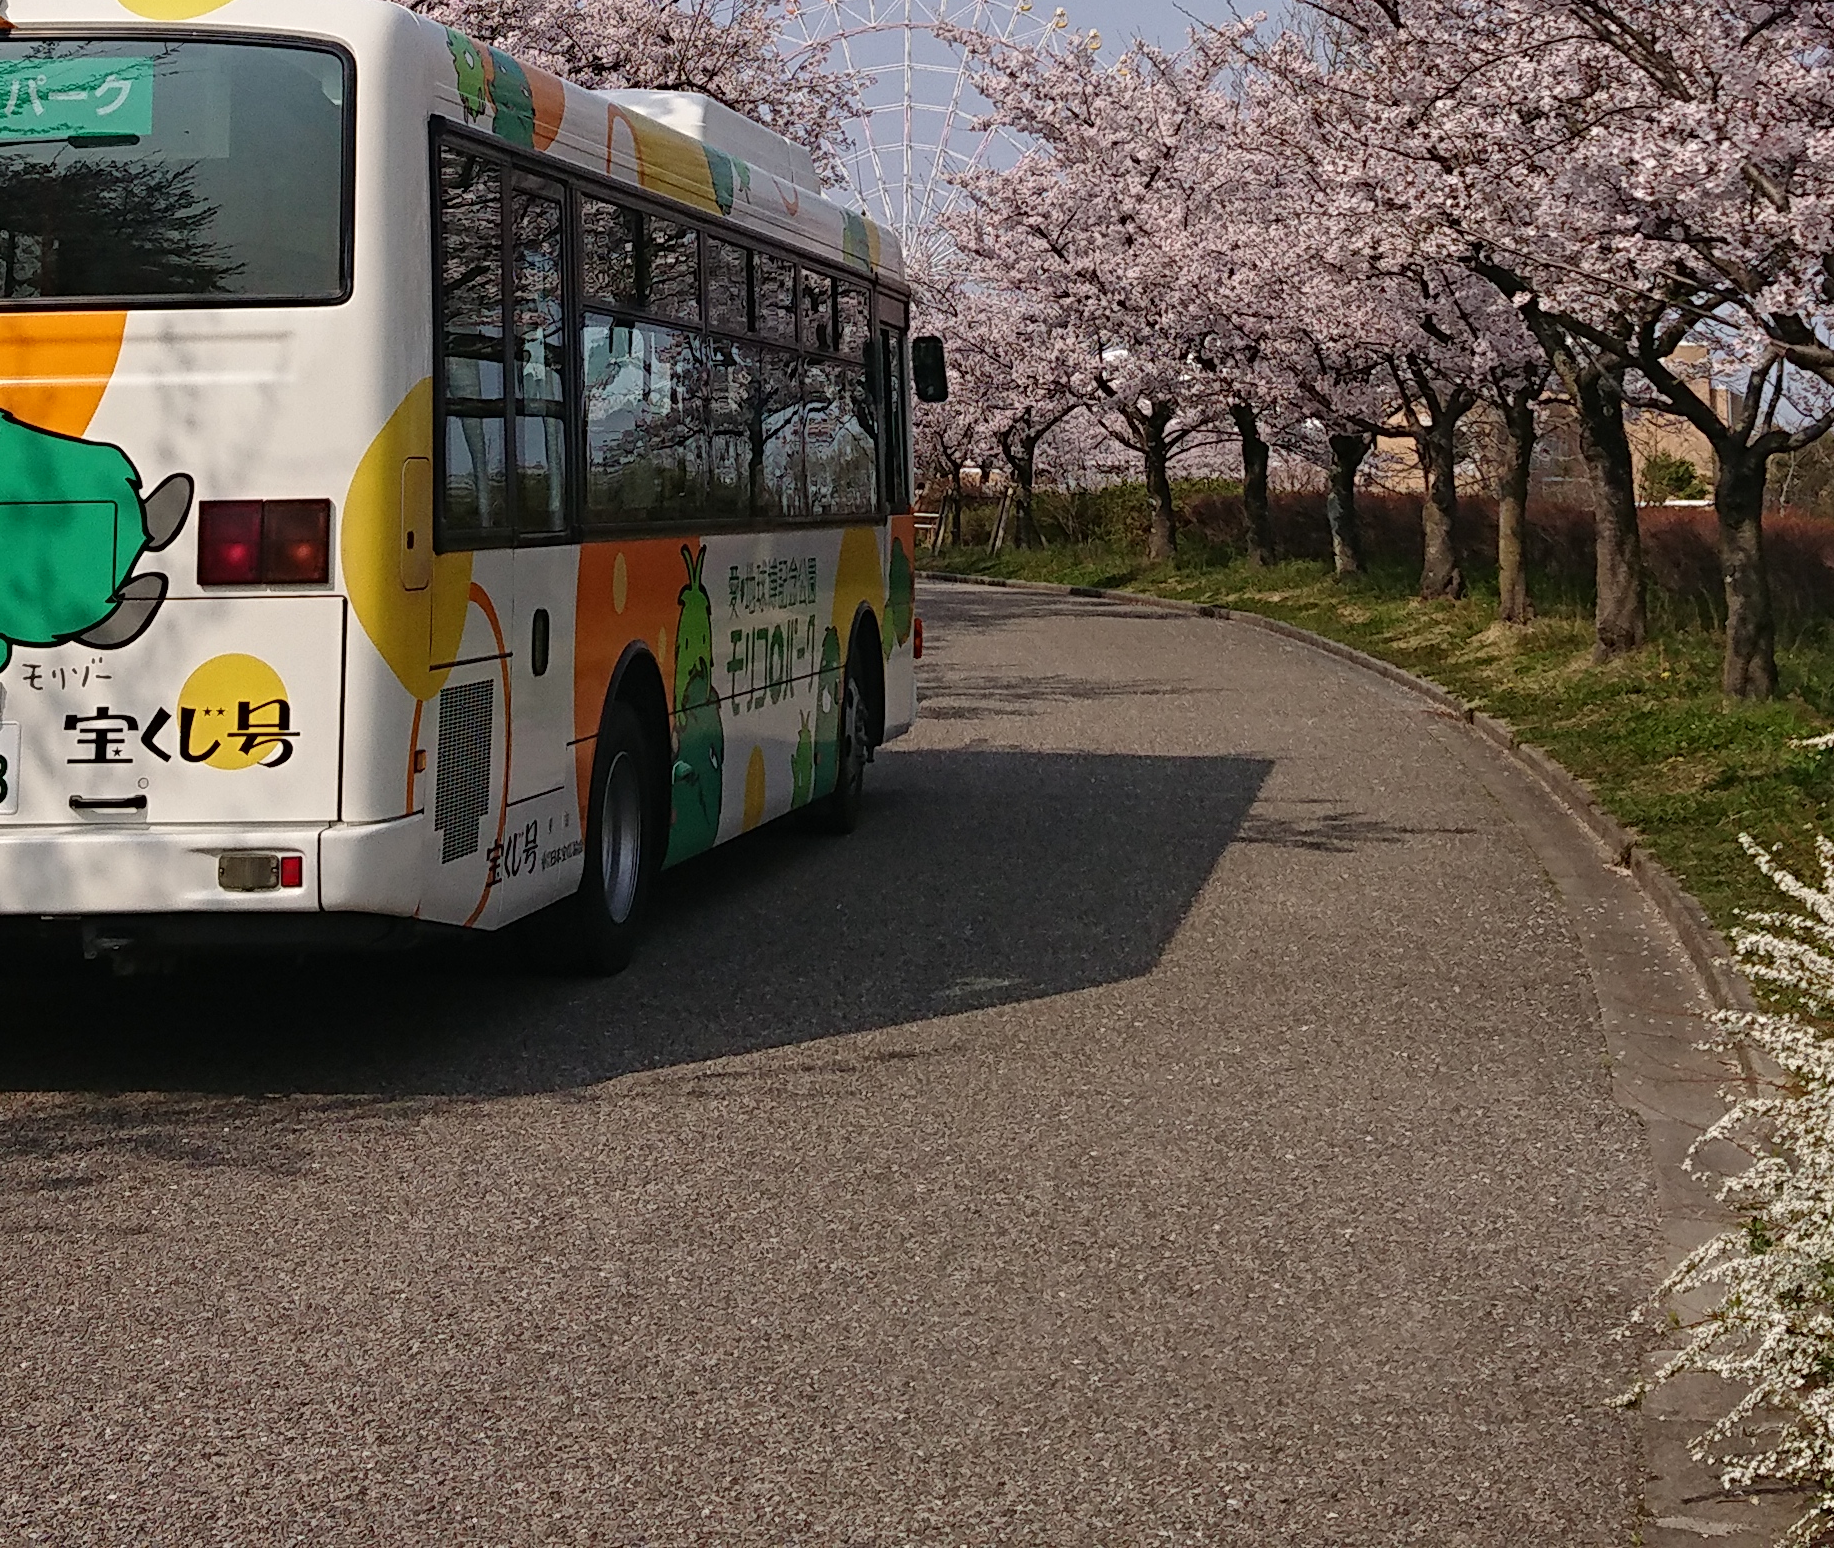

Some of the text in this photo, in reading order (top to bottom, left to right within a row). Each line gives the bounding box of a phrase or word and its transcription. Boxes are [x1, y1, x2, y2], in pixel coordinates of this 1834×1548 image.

[22, 657, 112, 690] モリゾー
[727, 614, 816, 716] モリコロパーク
[64, 699, 301, 768] 宝くじ号
[486, 818, 539, 888] 宝くじ号
